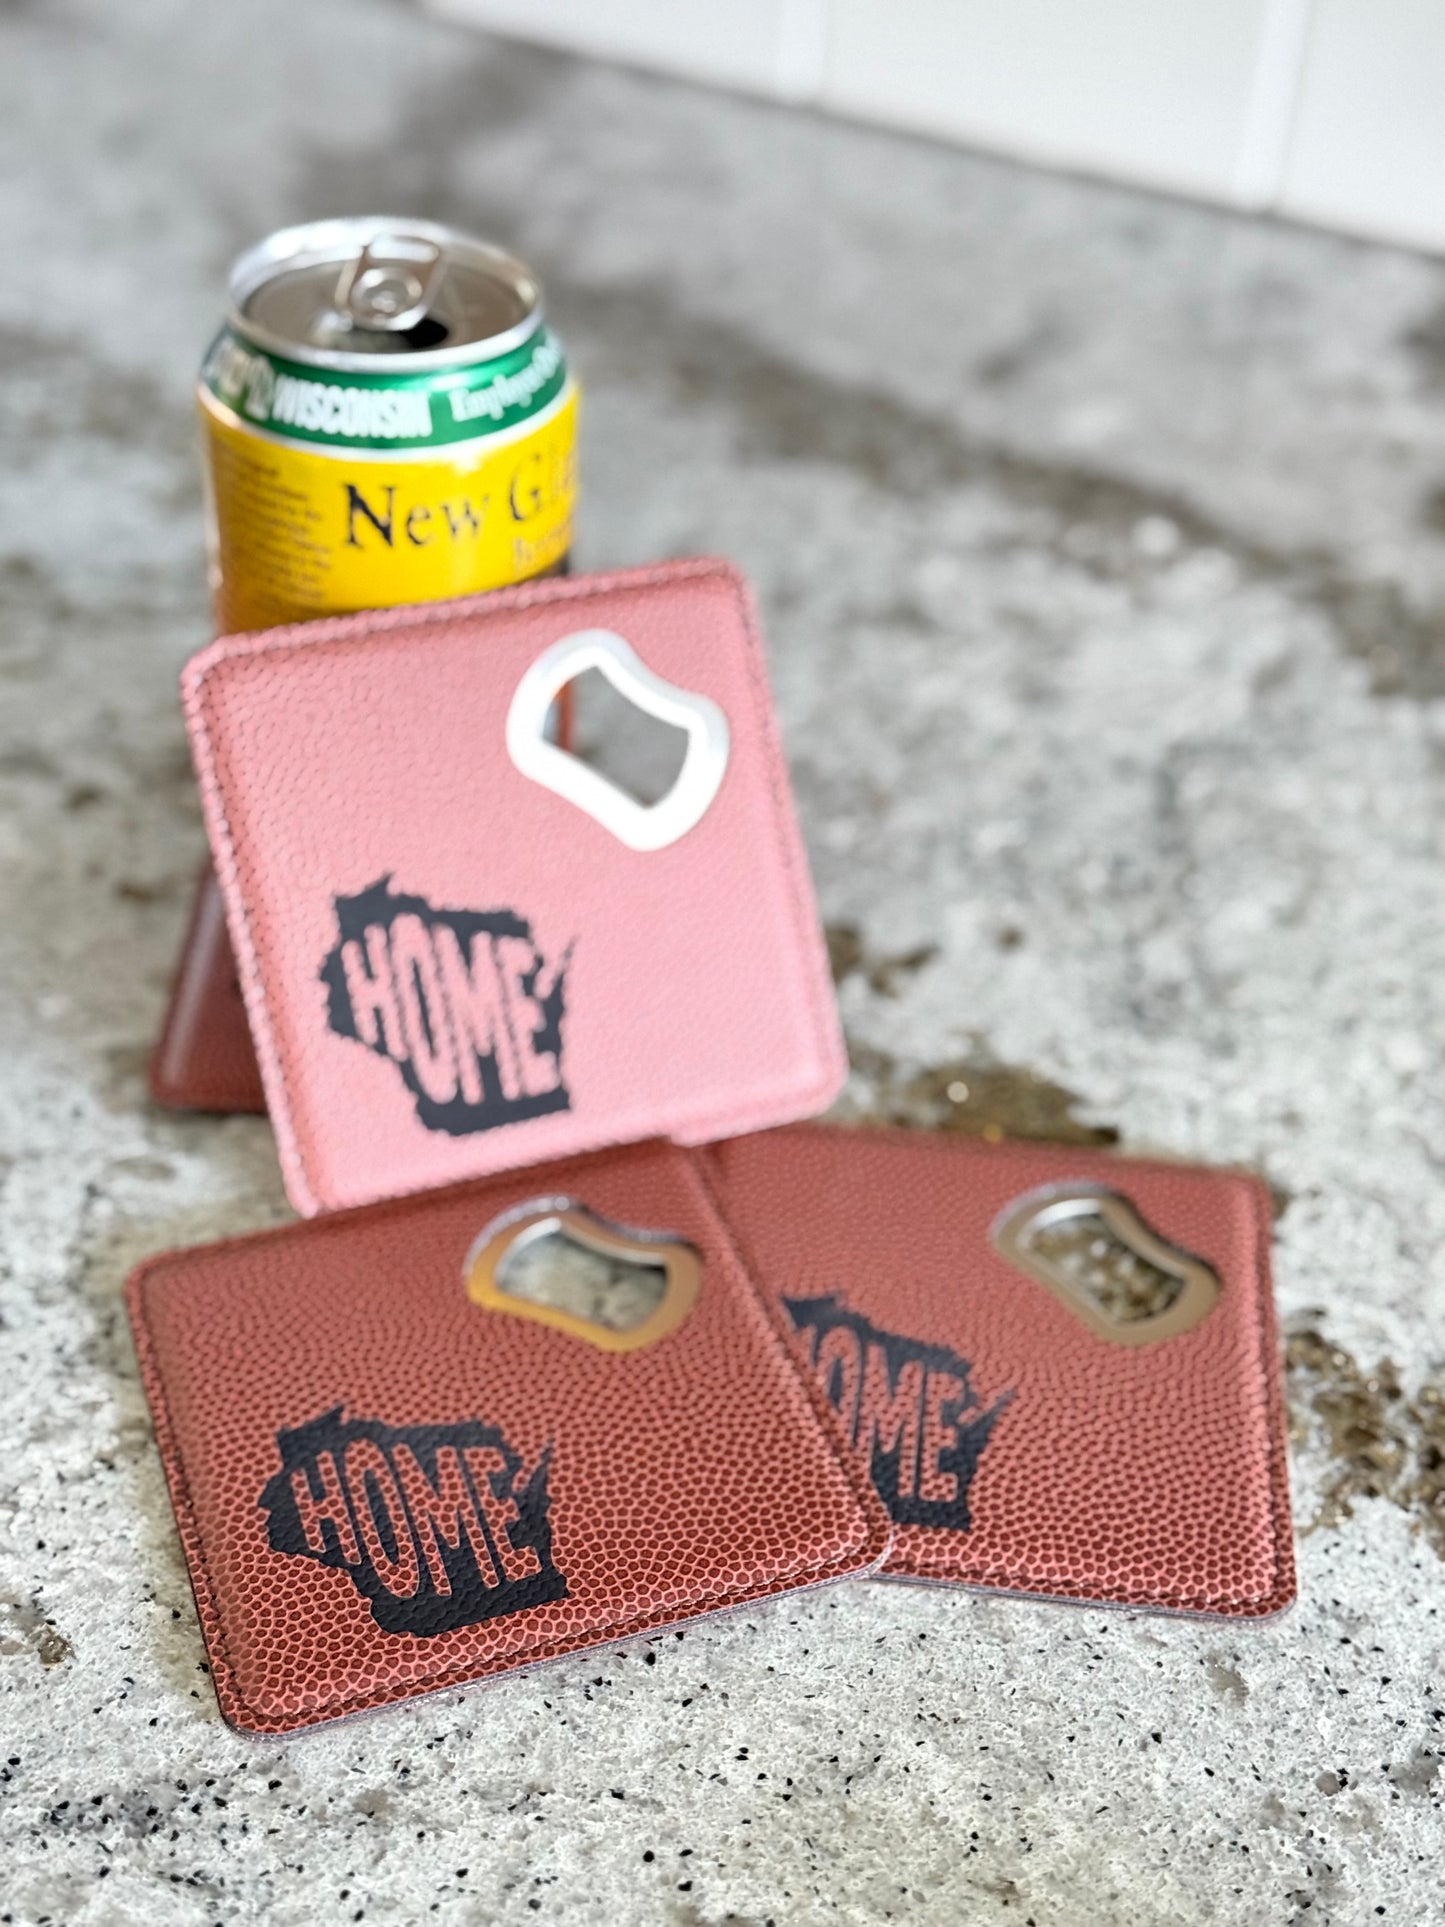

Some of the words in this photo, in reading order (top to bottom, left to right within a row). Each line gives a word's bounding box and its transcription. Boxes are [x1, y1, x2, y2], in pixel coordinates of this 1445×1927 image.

[273, 372, 434, 439] WISCONSIN
[342, 484, 491, 549] New
[341, 912, 561, 1105] HOME
[290, 1437, 543, 1600] HOME
